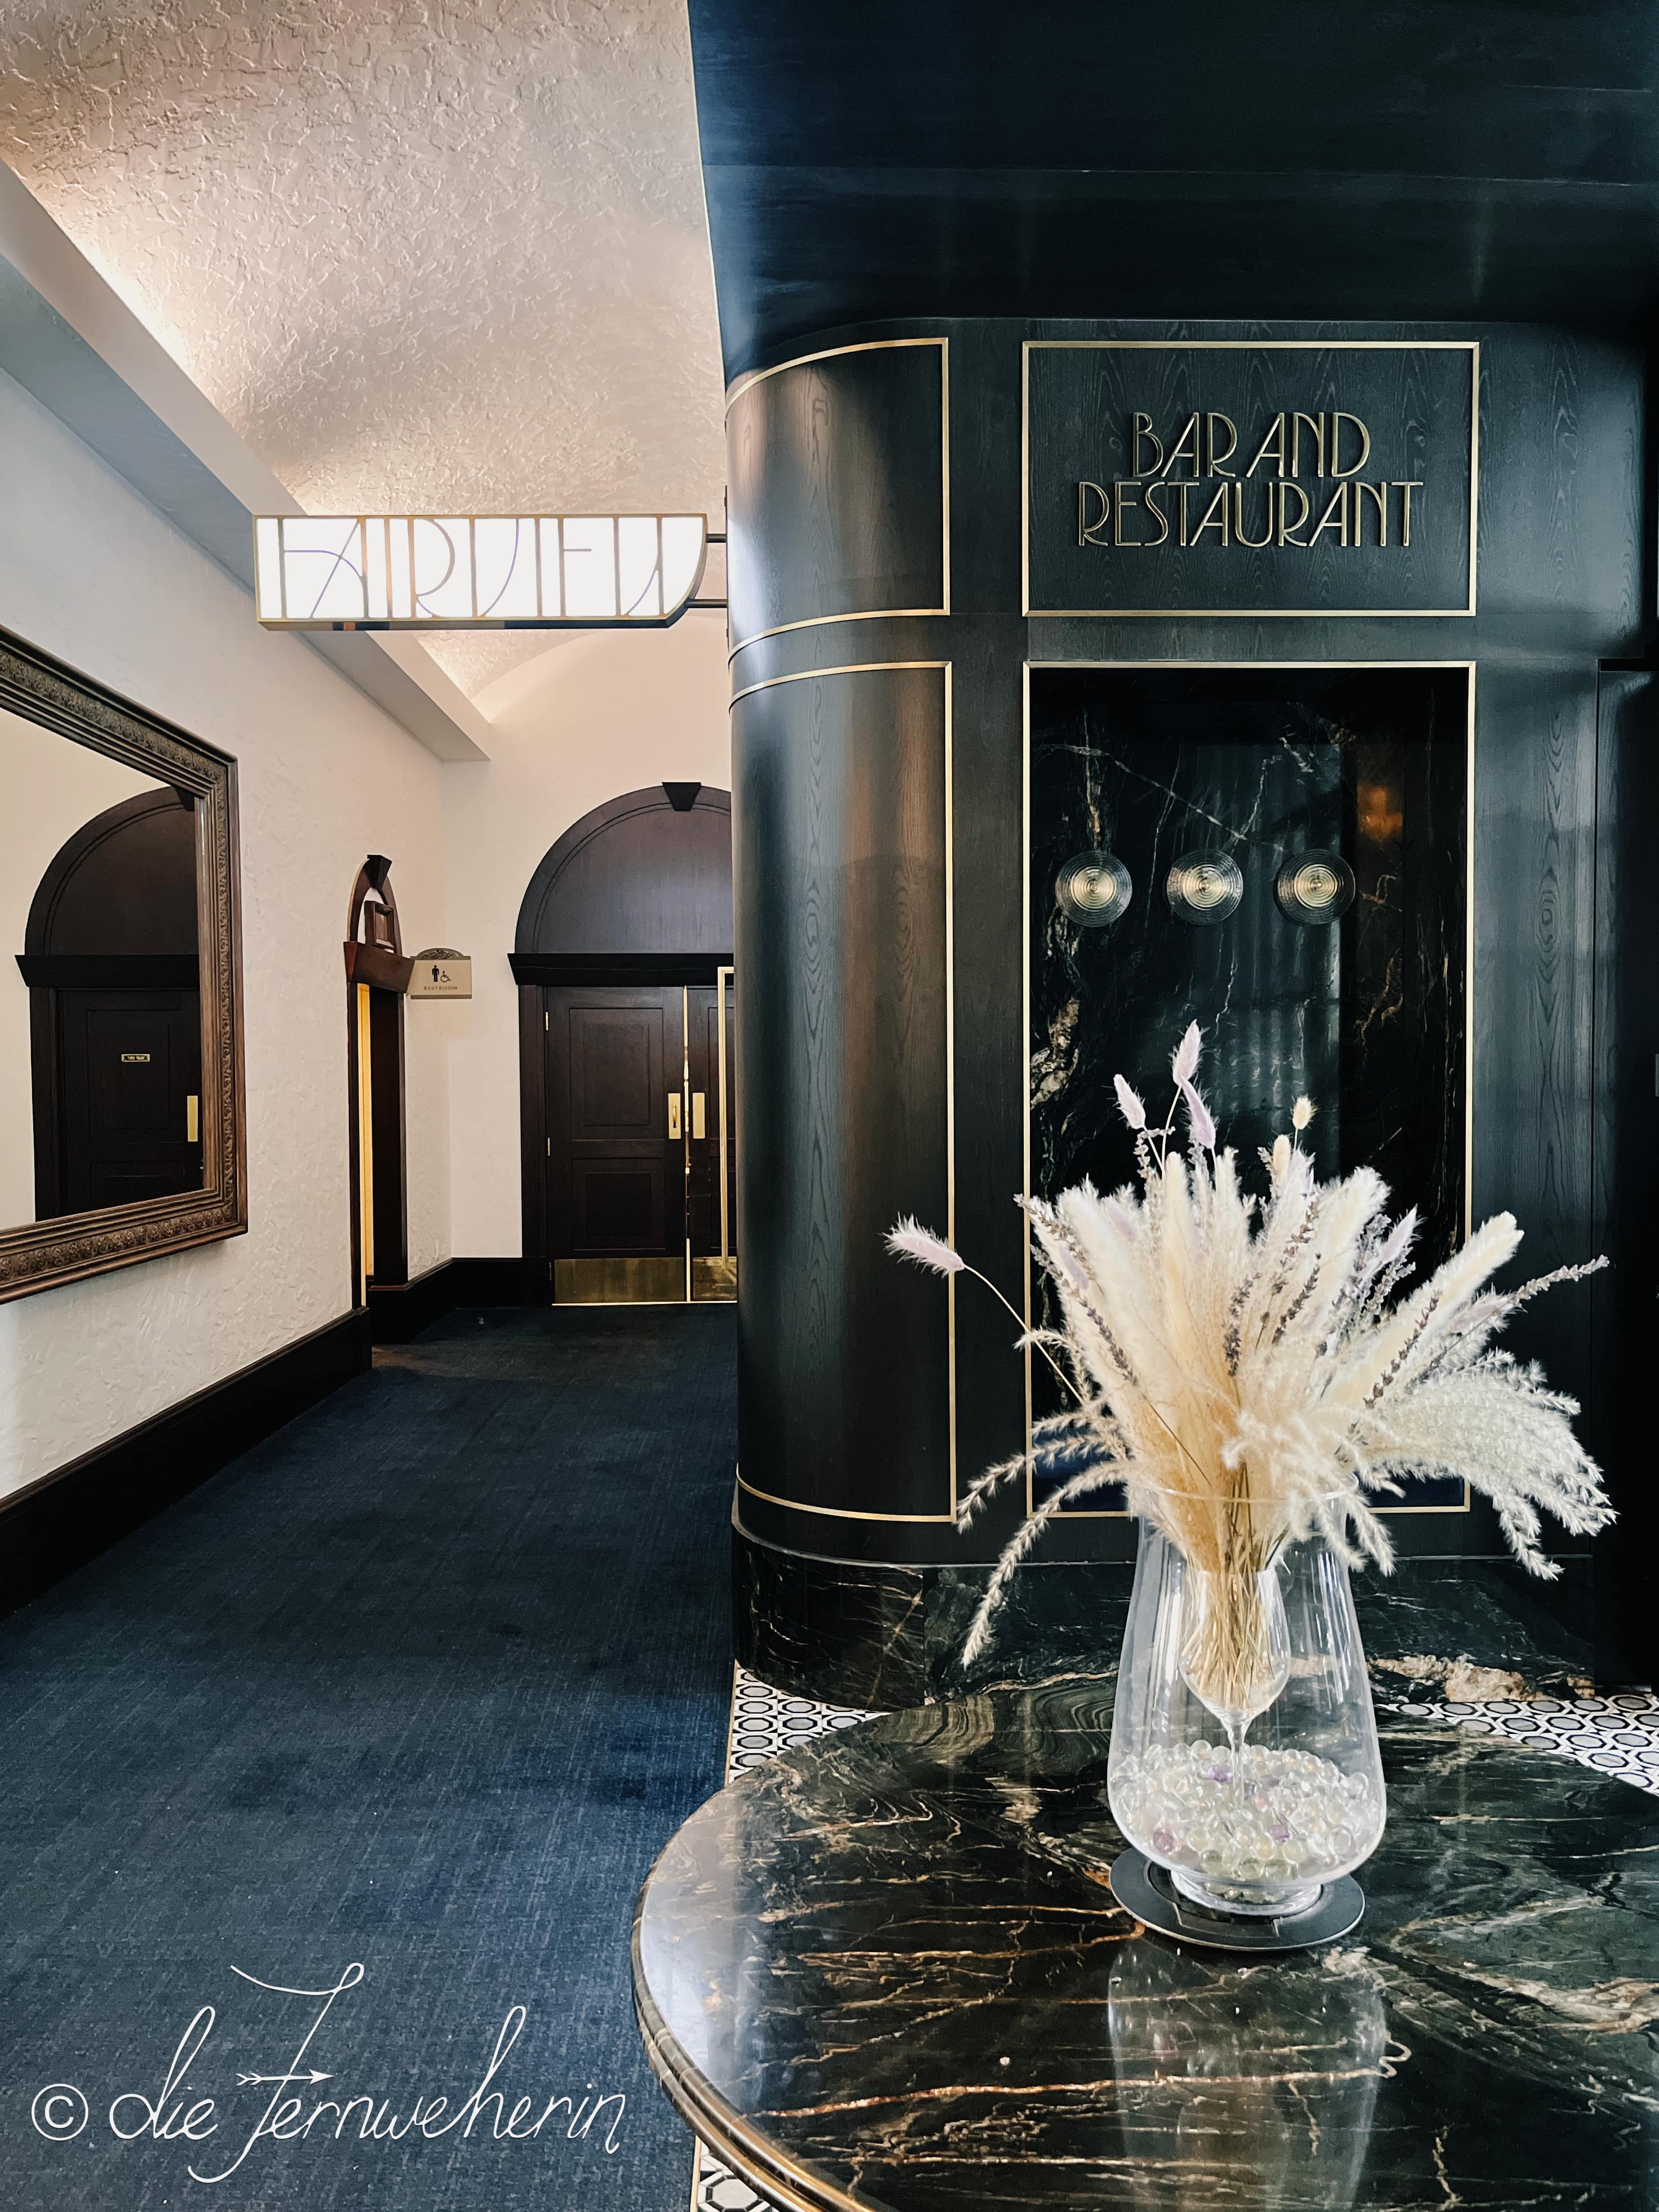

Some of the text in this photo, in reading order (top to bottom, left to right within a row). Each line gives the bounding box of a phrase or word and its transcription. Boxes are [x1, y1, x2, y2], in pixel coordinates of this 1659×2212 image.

[1132, 412, 1370, 478] BAR AND
[1078, 481, 1424, 547] RESTAURANT
